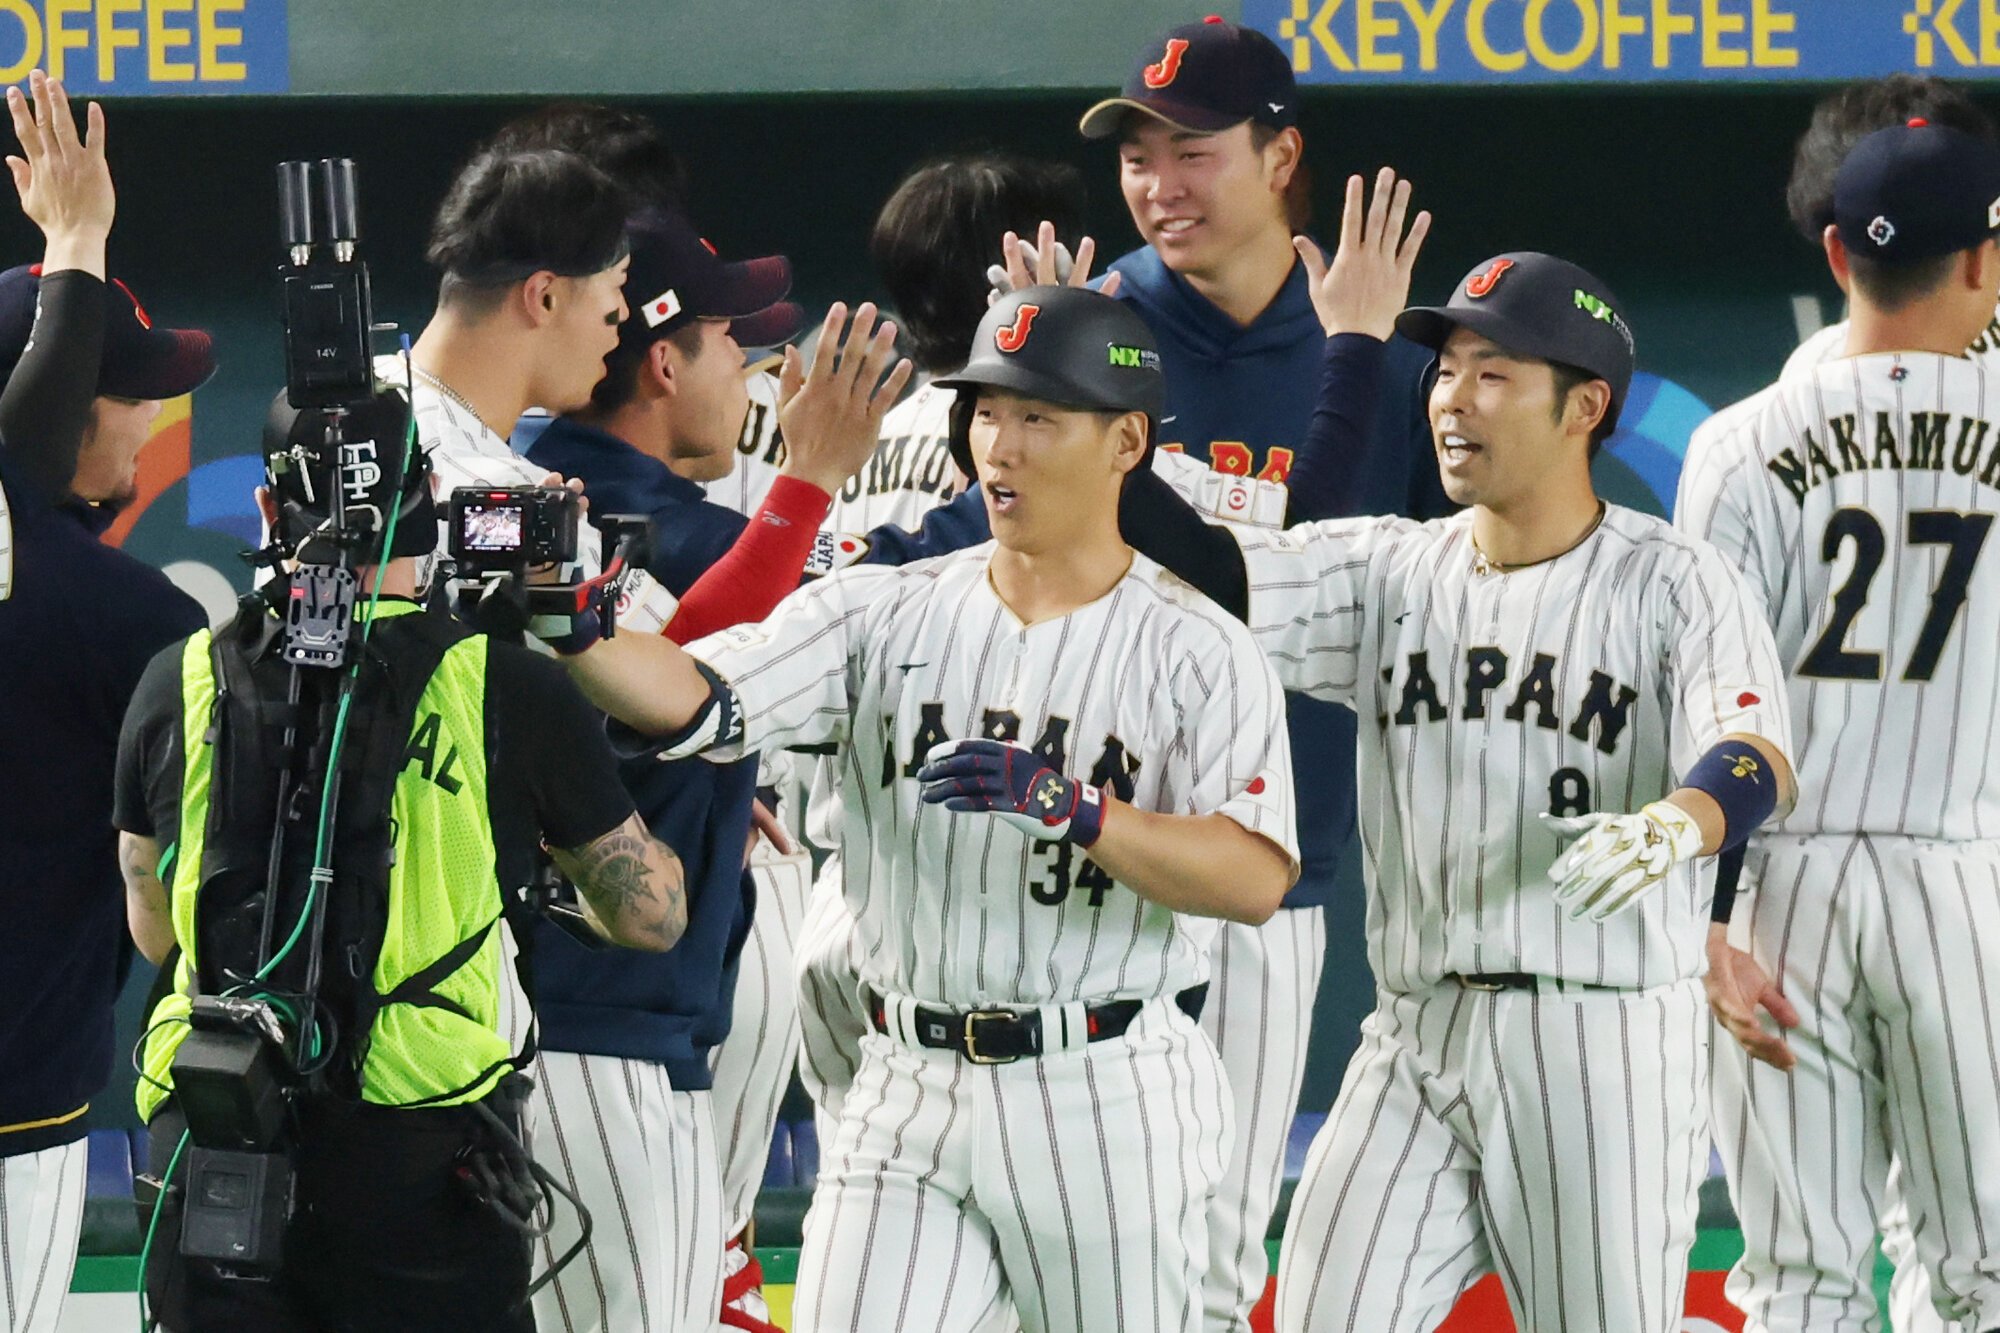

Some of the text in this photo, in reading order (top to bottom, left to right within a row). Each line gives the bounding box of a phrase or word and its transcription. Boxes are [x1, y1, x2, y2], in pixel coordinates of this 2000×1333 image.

[1144, 38, 1189, 89] J
[1465, 258, 1514, 302] J
[995, 303, 1040, 353] J
[1796, 506, 1996, 682] 27
[1029, 838, 1115, 907] 34
